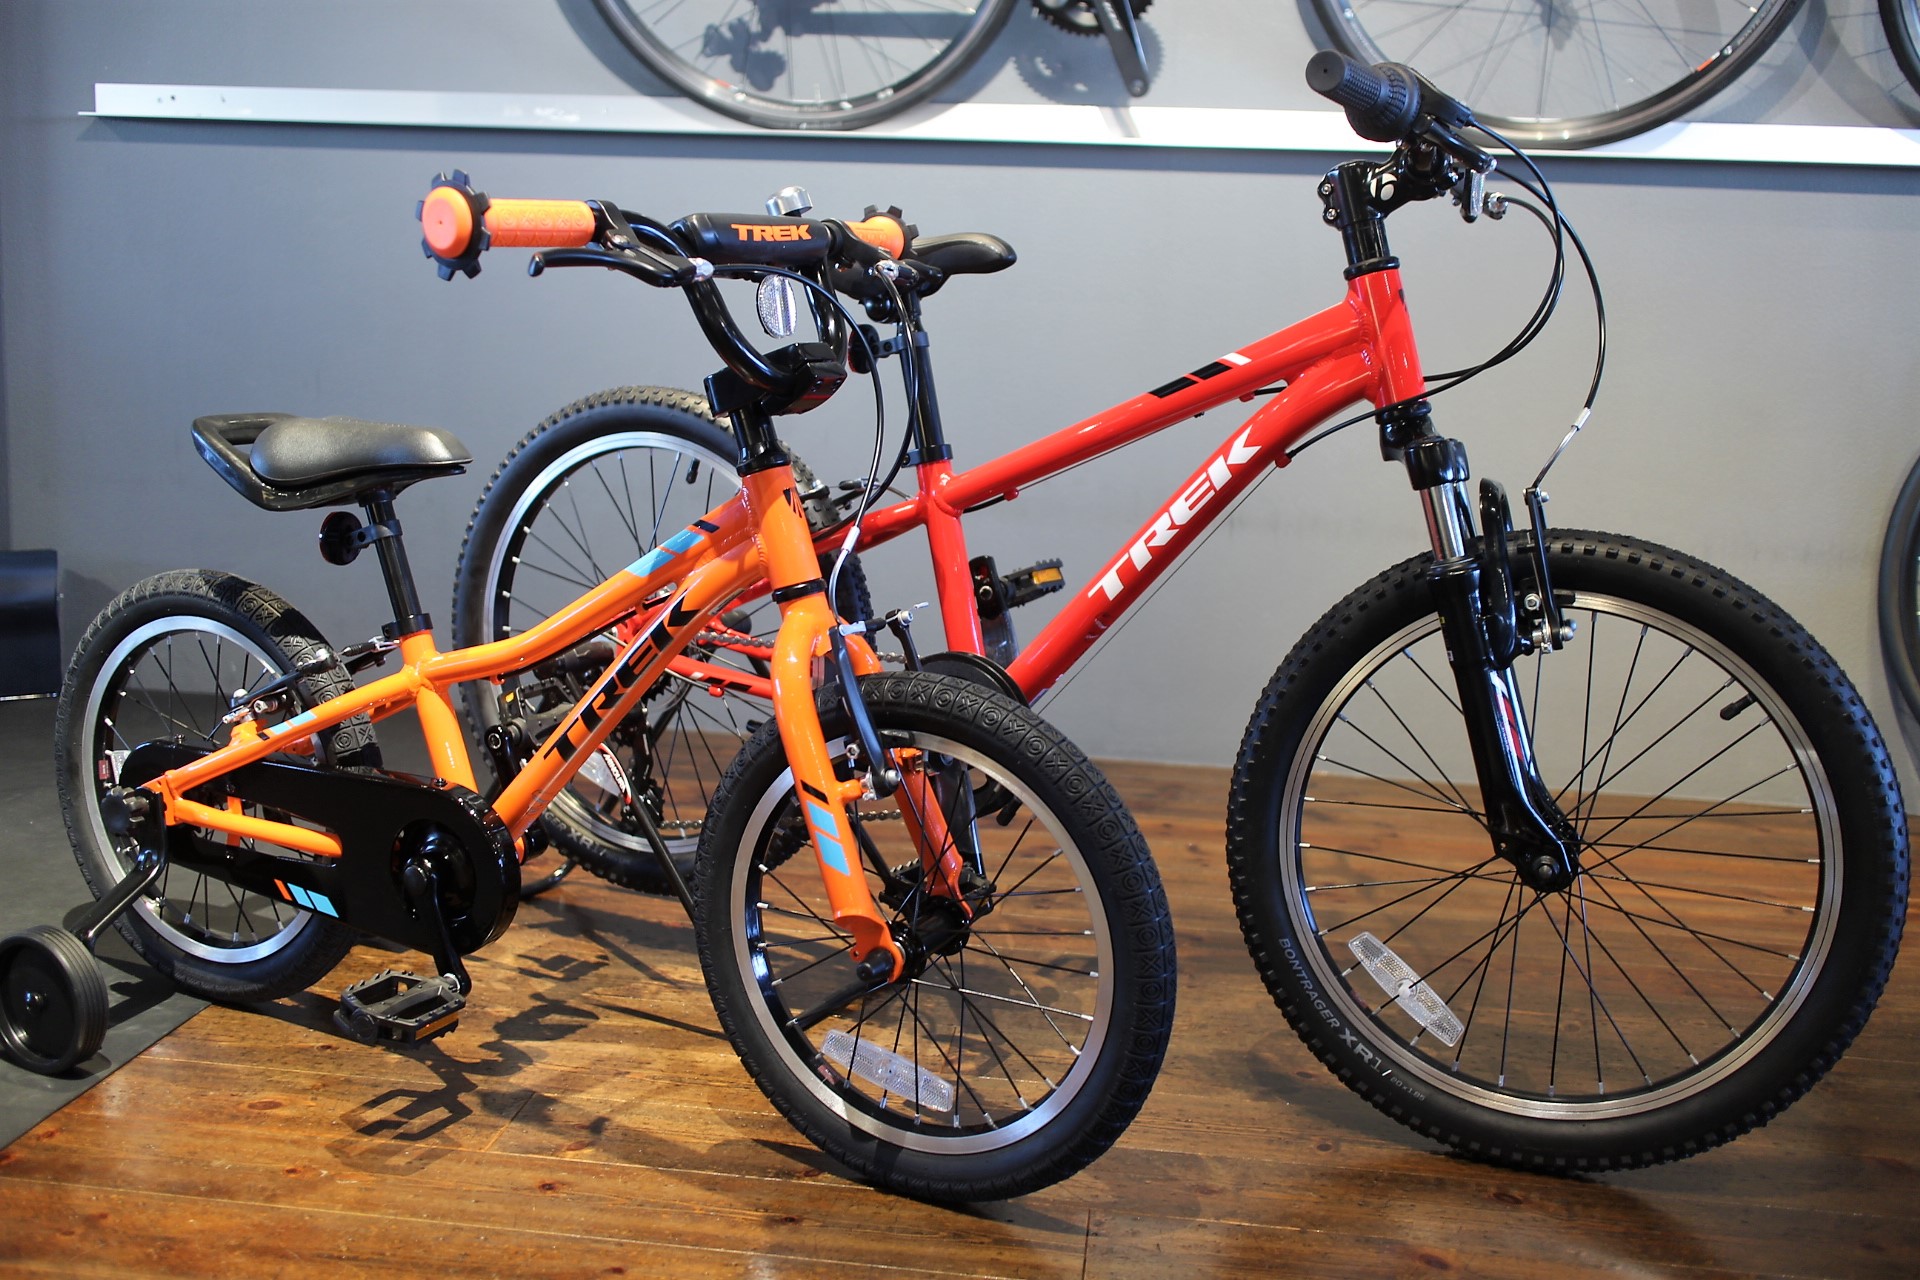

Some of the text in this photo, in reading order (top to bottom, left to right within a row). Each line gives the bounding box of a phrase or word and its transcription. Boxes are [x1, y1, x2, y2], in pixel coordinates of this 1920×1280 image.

[730, 223, 812, 242] TREK
[1087, 424, 1262, 601] TREK
[543, 588, 702, 763] TREK
[1279, 938, 1341, 1028] BONTRAGER
